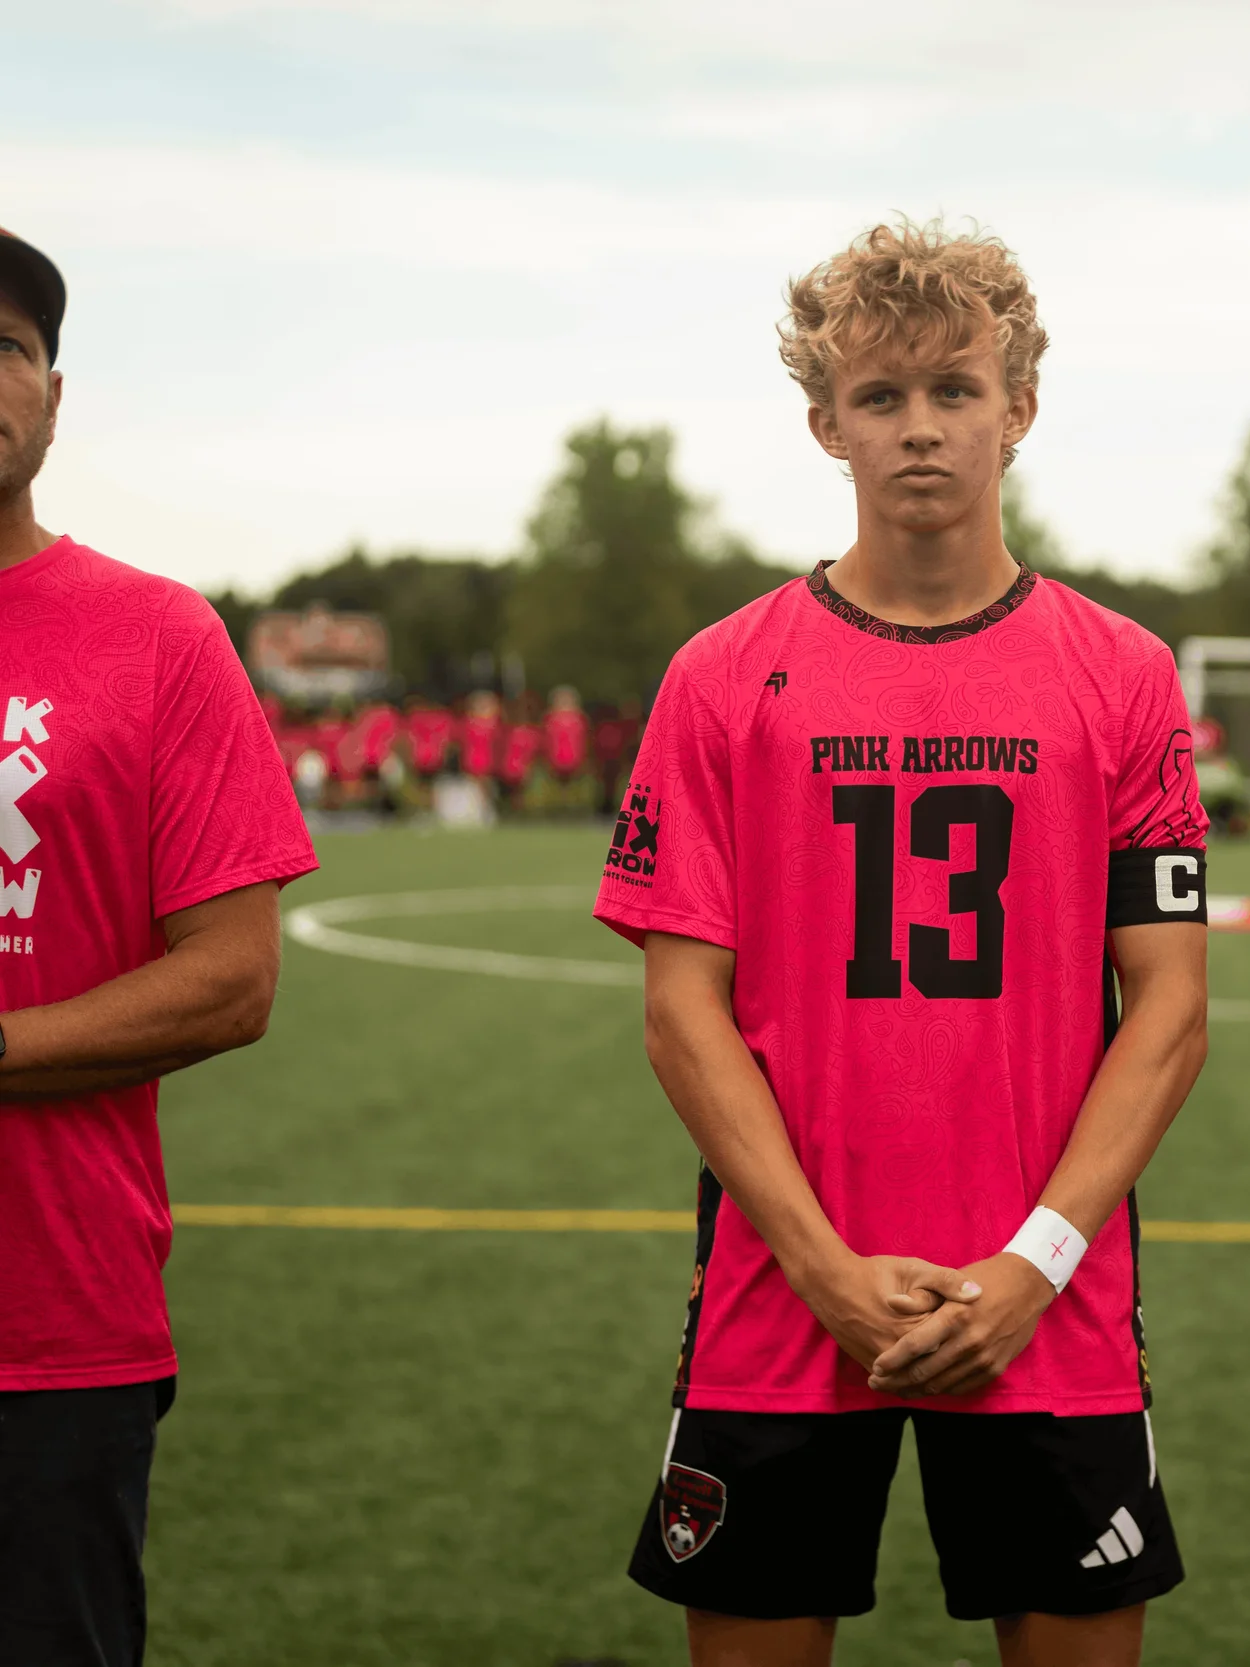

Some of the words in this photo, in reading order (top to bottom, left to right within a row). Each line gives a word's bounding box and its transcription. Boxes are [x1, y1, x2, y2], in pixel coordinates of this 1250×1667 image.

[810, 736, 890, 774] PINK
[901, 736, 1038, 775] ARROWS
[606, 848, 656, 876] ROW
[1155, 855, 1198, 912] C
[832, 784, 1014, 999] 13
